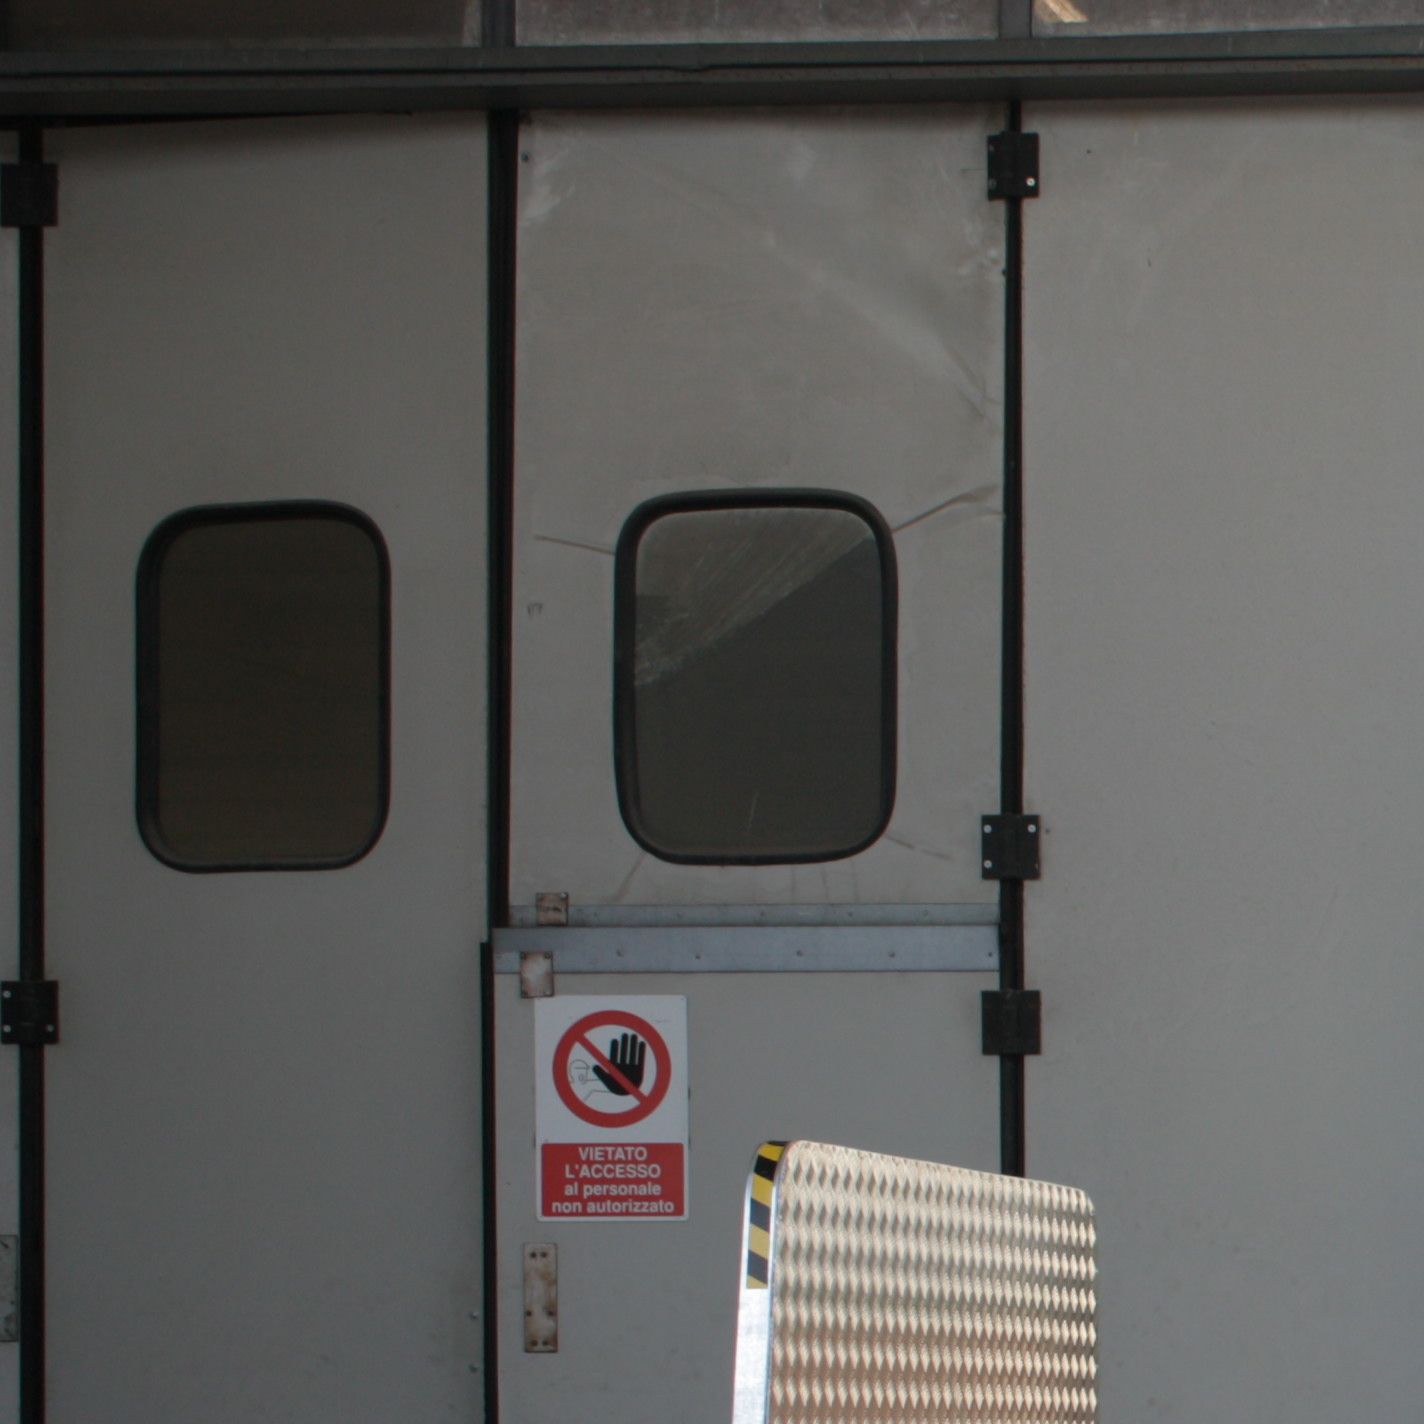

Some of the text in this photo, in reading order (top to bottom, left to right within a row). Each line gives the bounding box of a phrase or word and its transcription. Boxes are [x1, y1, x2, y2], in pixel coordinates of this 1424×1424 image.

[578, 1147, 647, 1161] VIETATO
[565, 1164, 661, 1179] L'ACCESSO
[564, 1181, 662, 1199] al personale
[552, 1199, 675, 1214] non autorizzato
